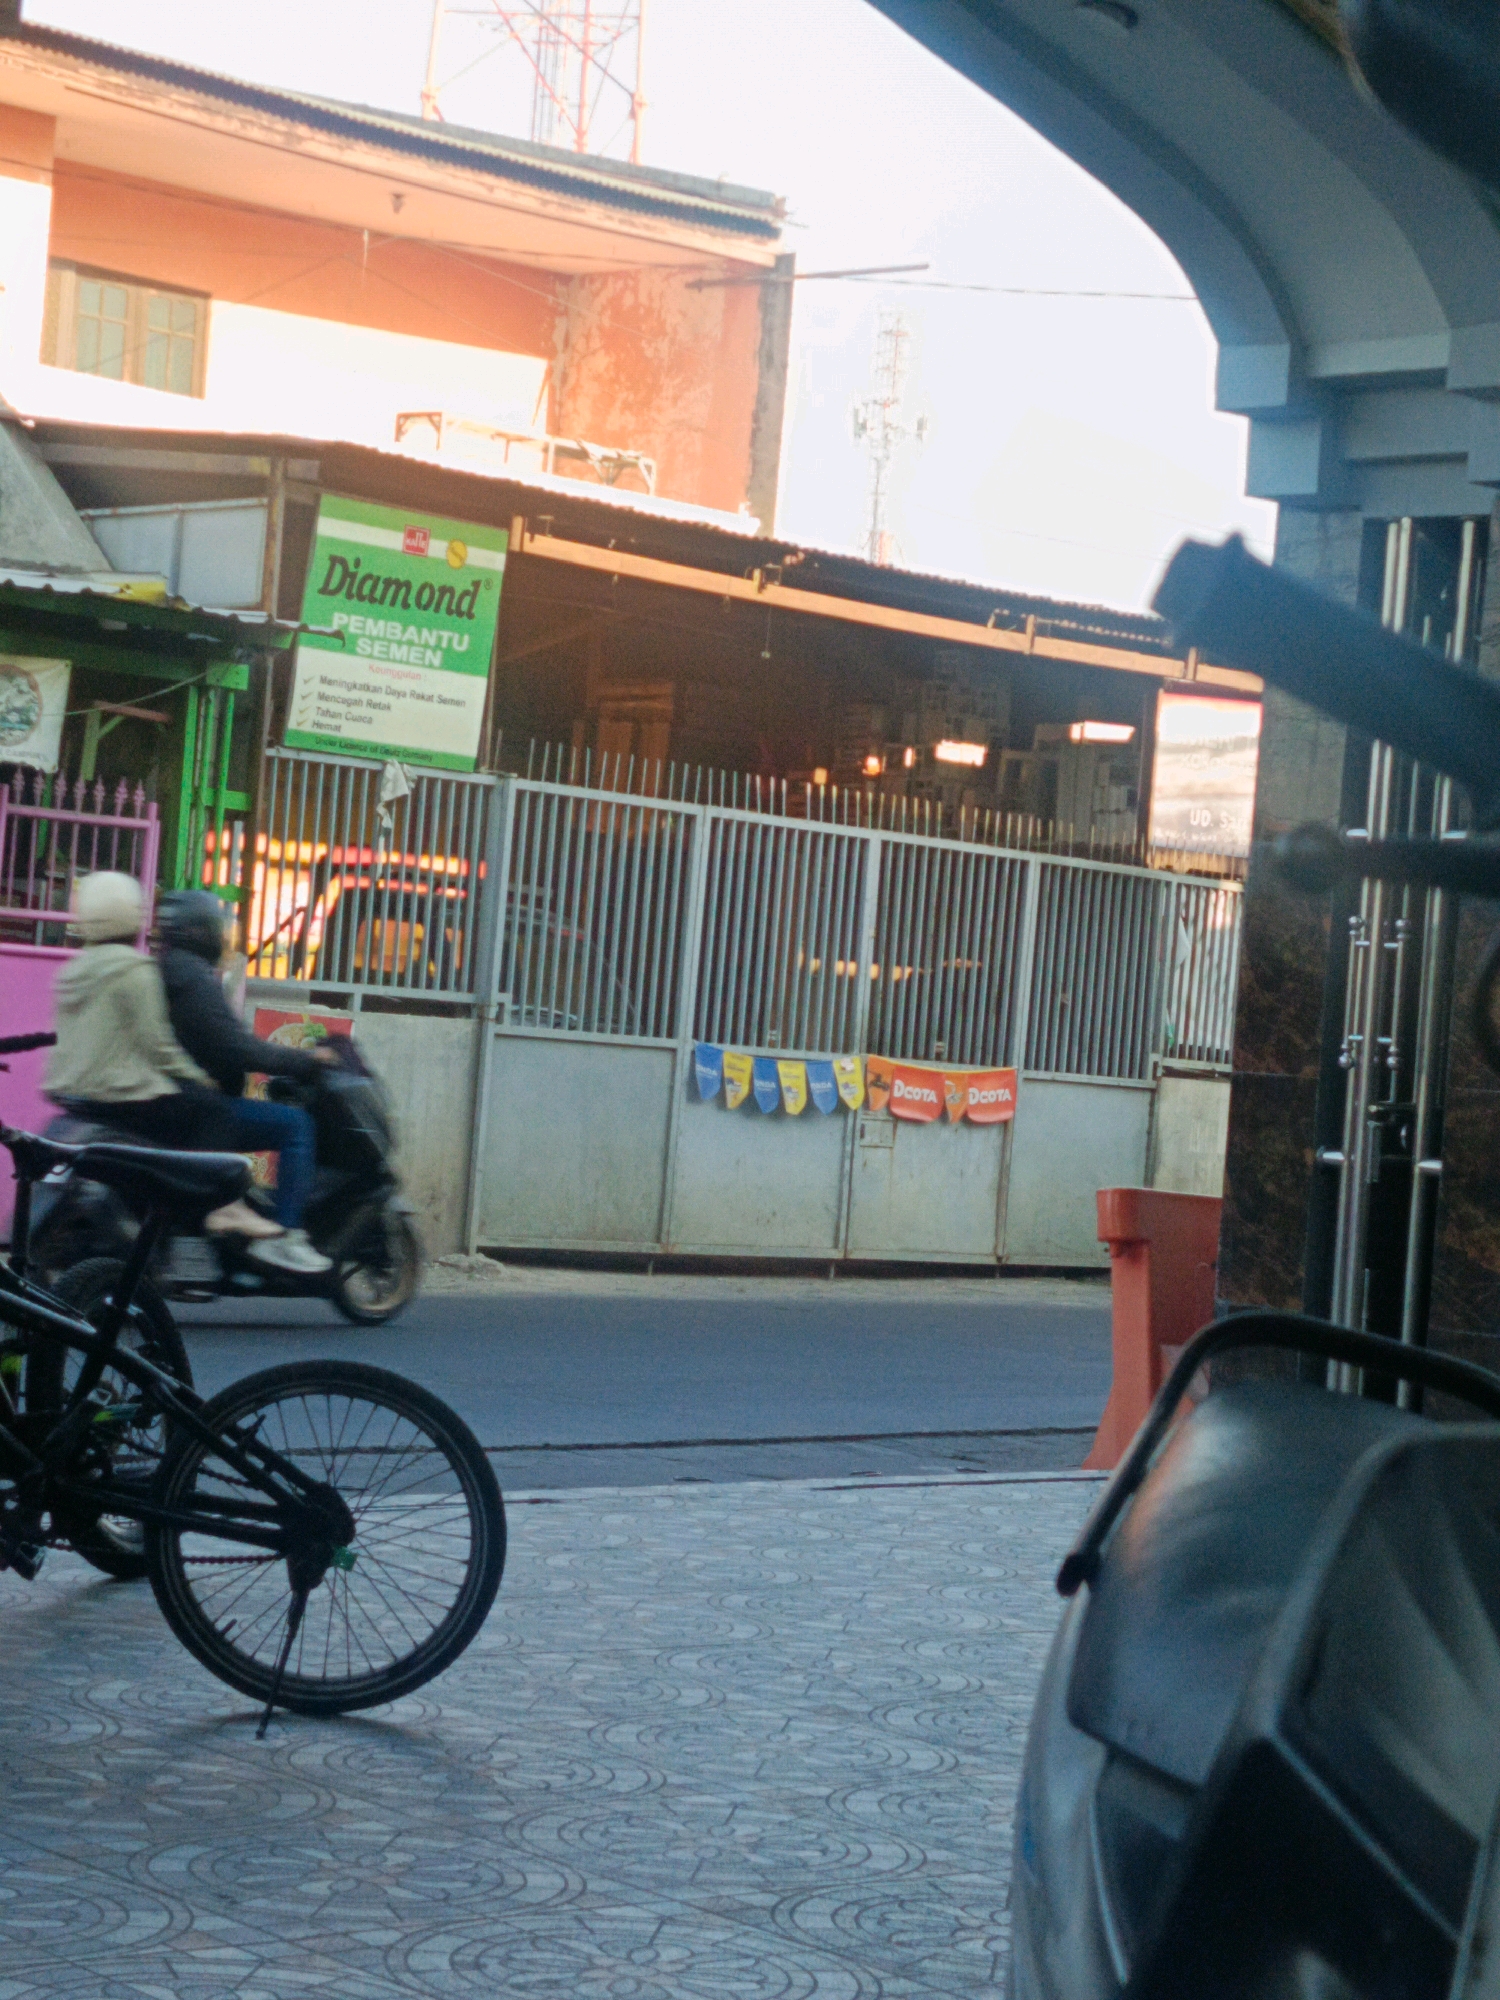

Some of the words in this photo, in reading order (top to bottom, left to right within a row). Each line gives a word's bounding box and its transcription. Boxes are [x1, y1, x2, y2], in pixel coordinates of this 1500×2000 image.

[317, 554, 482, 620] Diamond
[332, 612, 470, 652] PEMBANTU
[355, 637, 443, 667] SEMEN
[317, 691, 364, 708] Mencegah
[366, 699, 392, 711] Retak
[319, 675, 383, 694] Meningkatkan
[385, 684, 407, 699] Daya
[409, 689, 434, 703] Rekat
[437, 694, 467, 708] Semen
[311, 720, 342, 733] Hemat
[315, 706, 343, 720] Tahan
[345, 711, 374, 725] Cuaca
